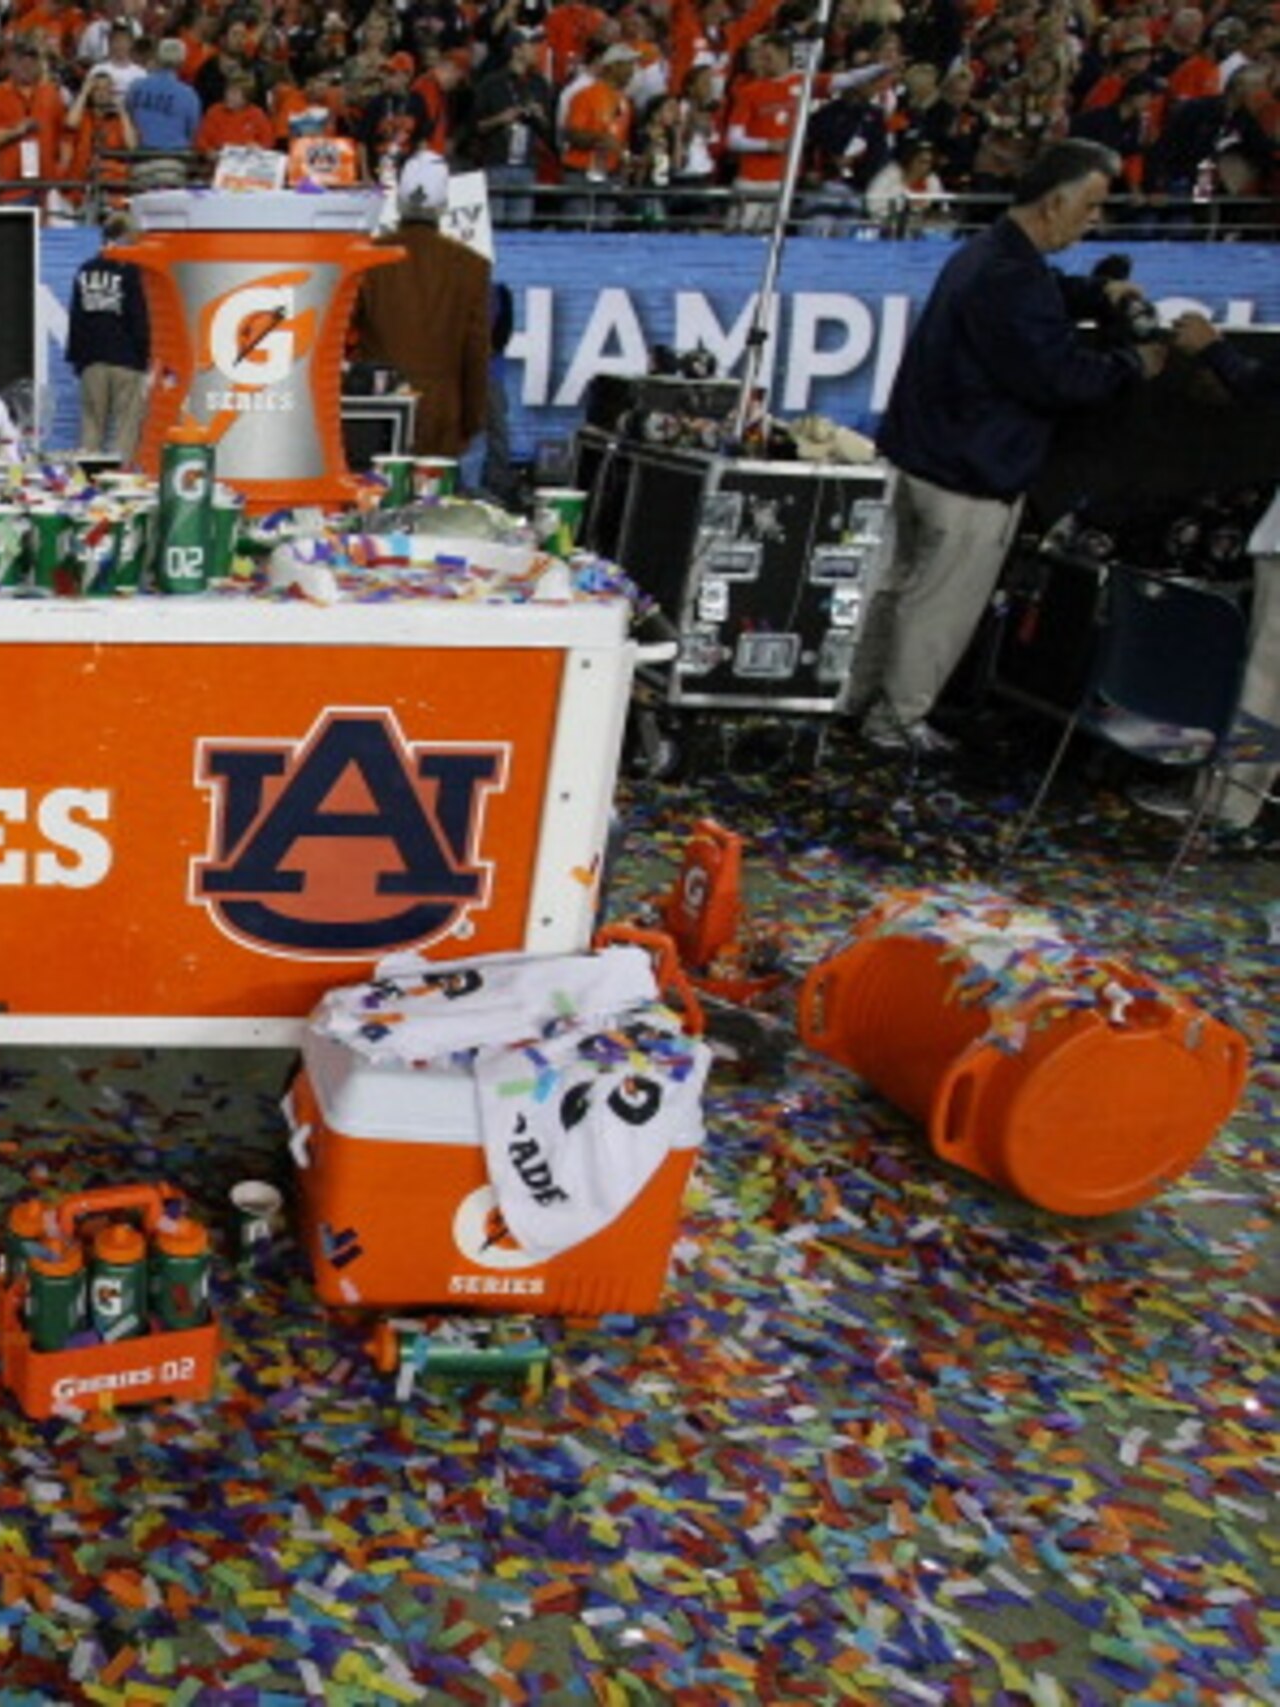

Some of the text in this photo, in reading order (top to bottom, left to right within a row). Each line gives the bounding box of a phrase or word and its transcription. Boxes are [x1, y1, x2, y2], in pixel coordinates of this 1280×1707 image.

[205, 390, 296, 412] SERIES
[166, 546, 205, 579] 02
[447, 1273, 545, 1296] SERIES
[160, 1355, 196, 1383] 02
